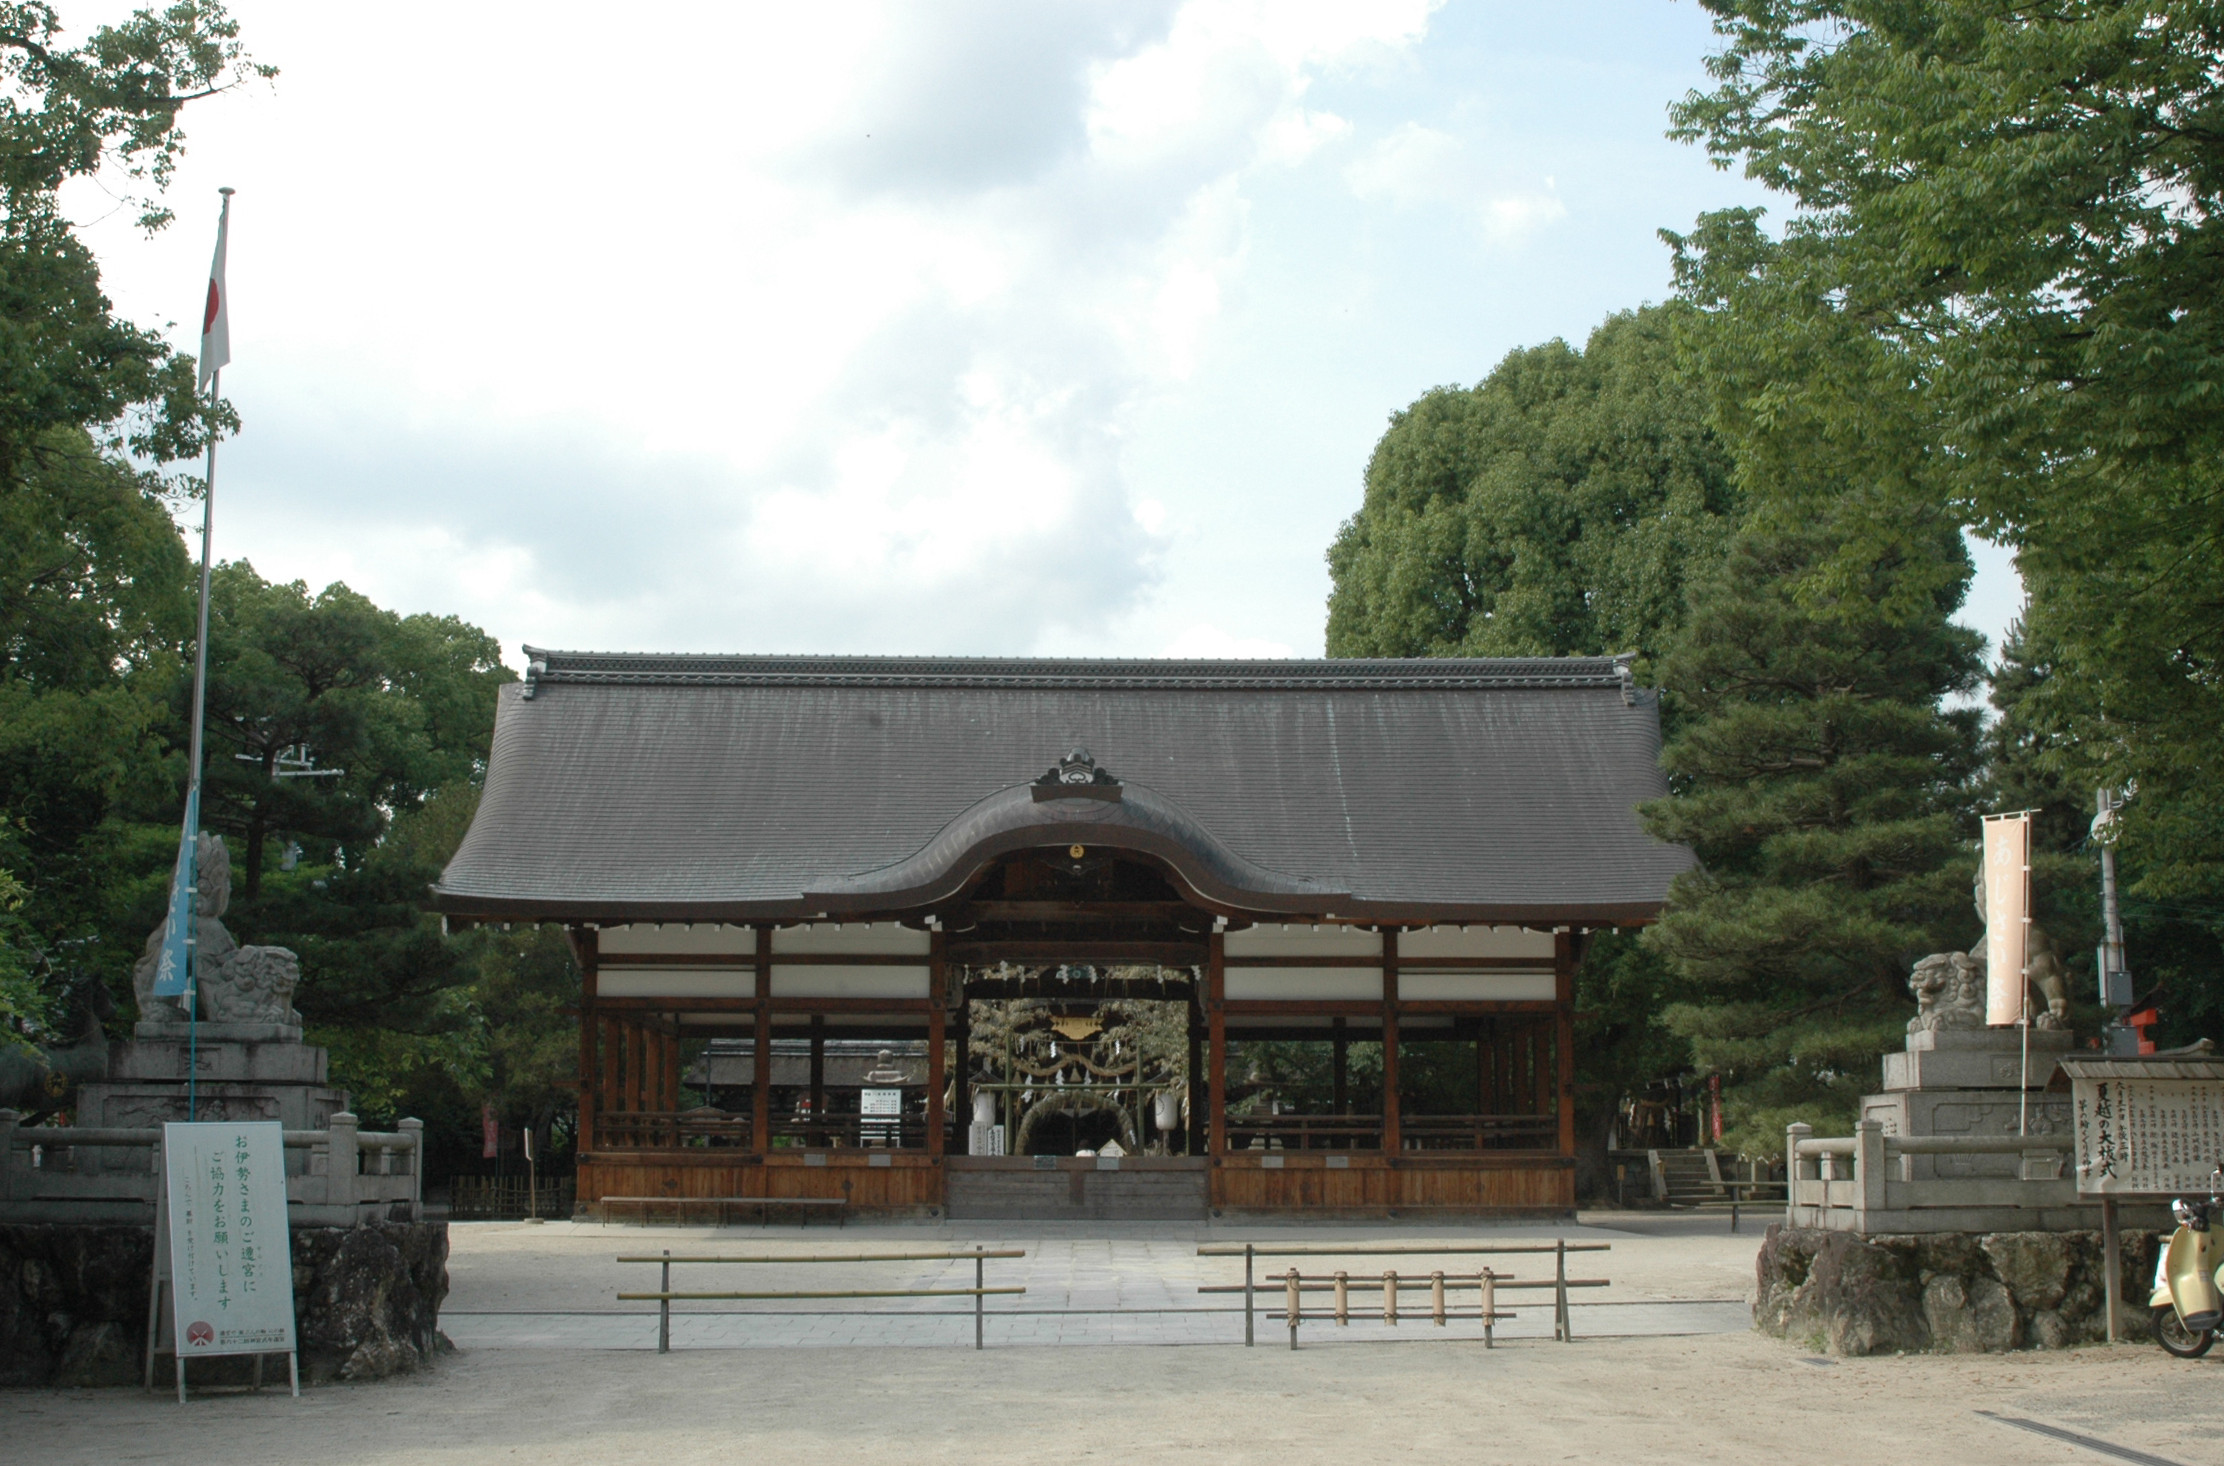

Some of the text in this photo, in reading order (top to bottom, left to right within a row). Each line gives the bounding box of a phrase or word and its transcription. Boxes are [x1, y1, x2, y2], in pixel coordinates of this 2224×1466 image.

[1987, 834, 2013, 1009] あじさい祭
[2095, 1081, 2118, 1180] 夏越の大祓式
[209, 1151, 232, 1311] ご協力をお願いします
[234, 1134, 257, 1293] お伊勢さまのご遷宮に
